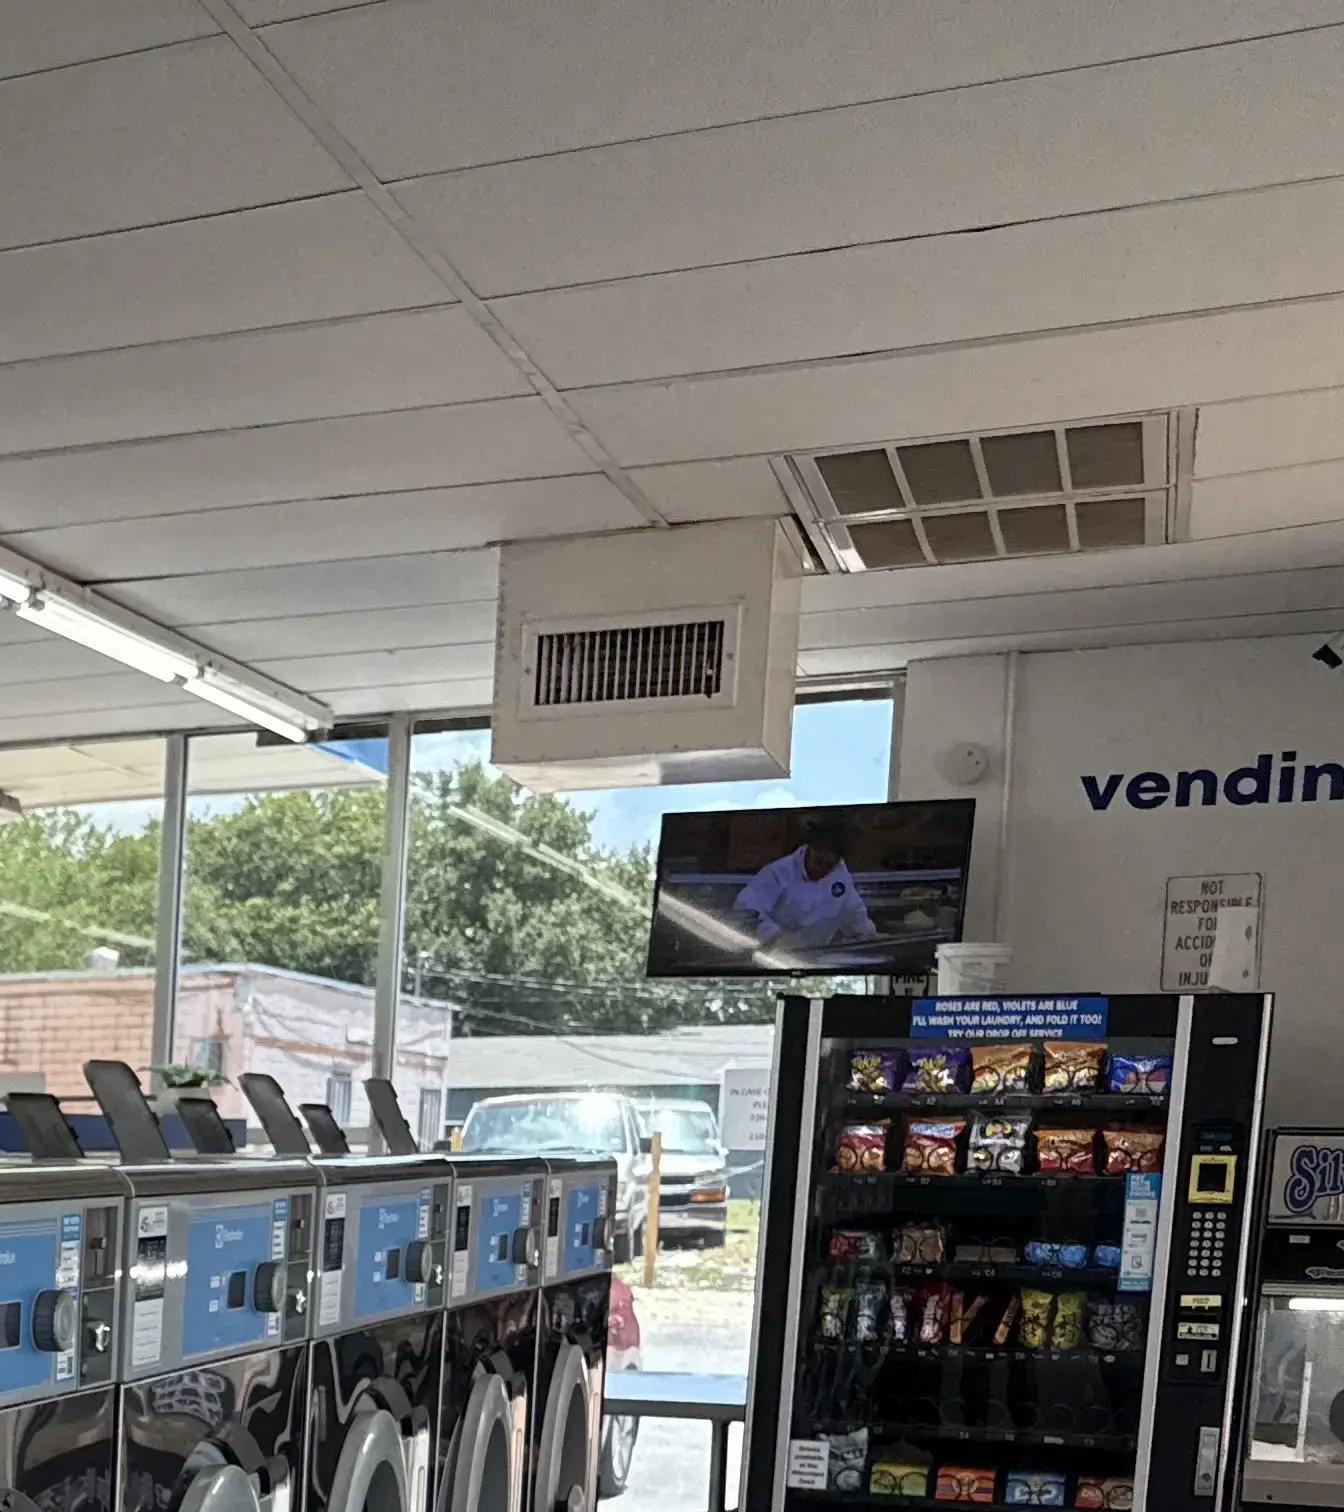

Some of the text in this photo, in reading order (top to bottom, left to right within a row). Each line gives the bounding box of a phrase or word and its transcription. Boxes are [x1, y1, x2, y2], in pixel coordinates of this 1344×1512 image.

[1200, 880, 1224, 895] NOT
[1175, 935, 1216, 951] ACCID
[1178, 972, 1208, 986] INJU
[935, 999, 1078, 1013] ROSES ARE RED, VIOLETS ARE BLUE
[928, 1015, 954, 1026] WASH
[956, 1015, 980, 1025] YOUR
[1025, 1014, 1044, 1025] AND
[1046, 1014, 1068, 1025] FOLD
[1070, 1014, 1078, 1024] IT
[948, 1029, 964, 1038] TRY
[965, 1029, 984, 1038] OUR
[986, 1029, 1010, 1038] DROP
[1284, 1145, 1344, 1213] Sil
